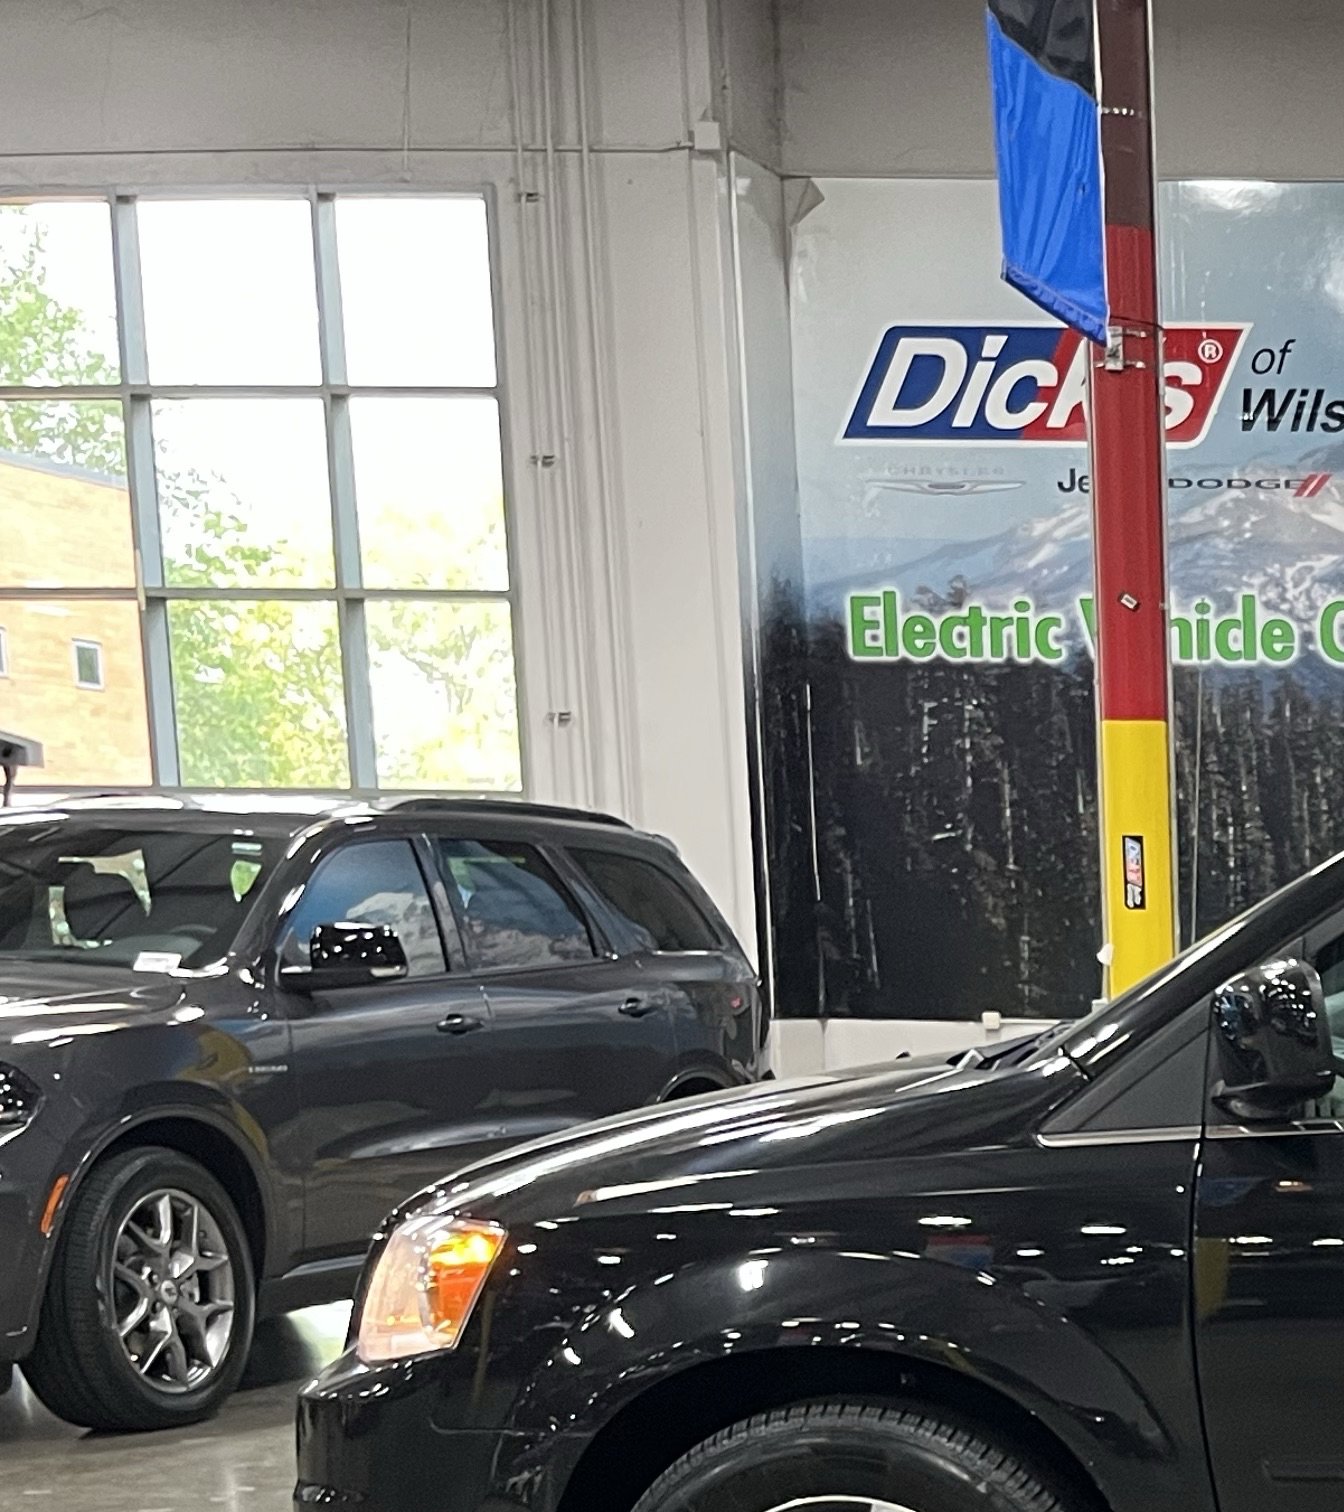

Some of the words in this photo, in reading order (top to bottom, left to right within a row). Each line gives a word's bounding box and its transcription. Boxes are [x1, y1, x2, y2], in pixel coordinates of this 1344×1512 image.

[1251, 338, 1296, 375] of
[1057, 468, 1090, 493] Je
[1168, 478, 1307, 489] DODGE
[849, 591, 1063, 659] Electric
